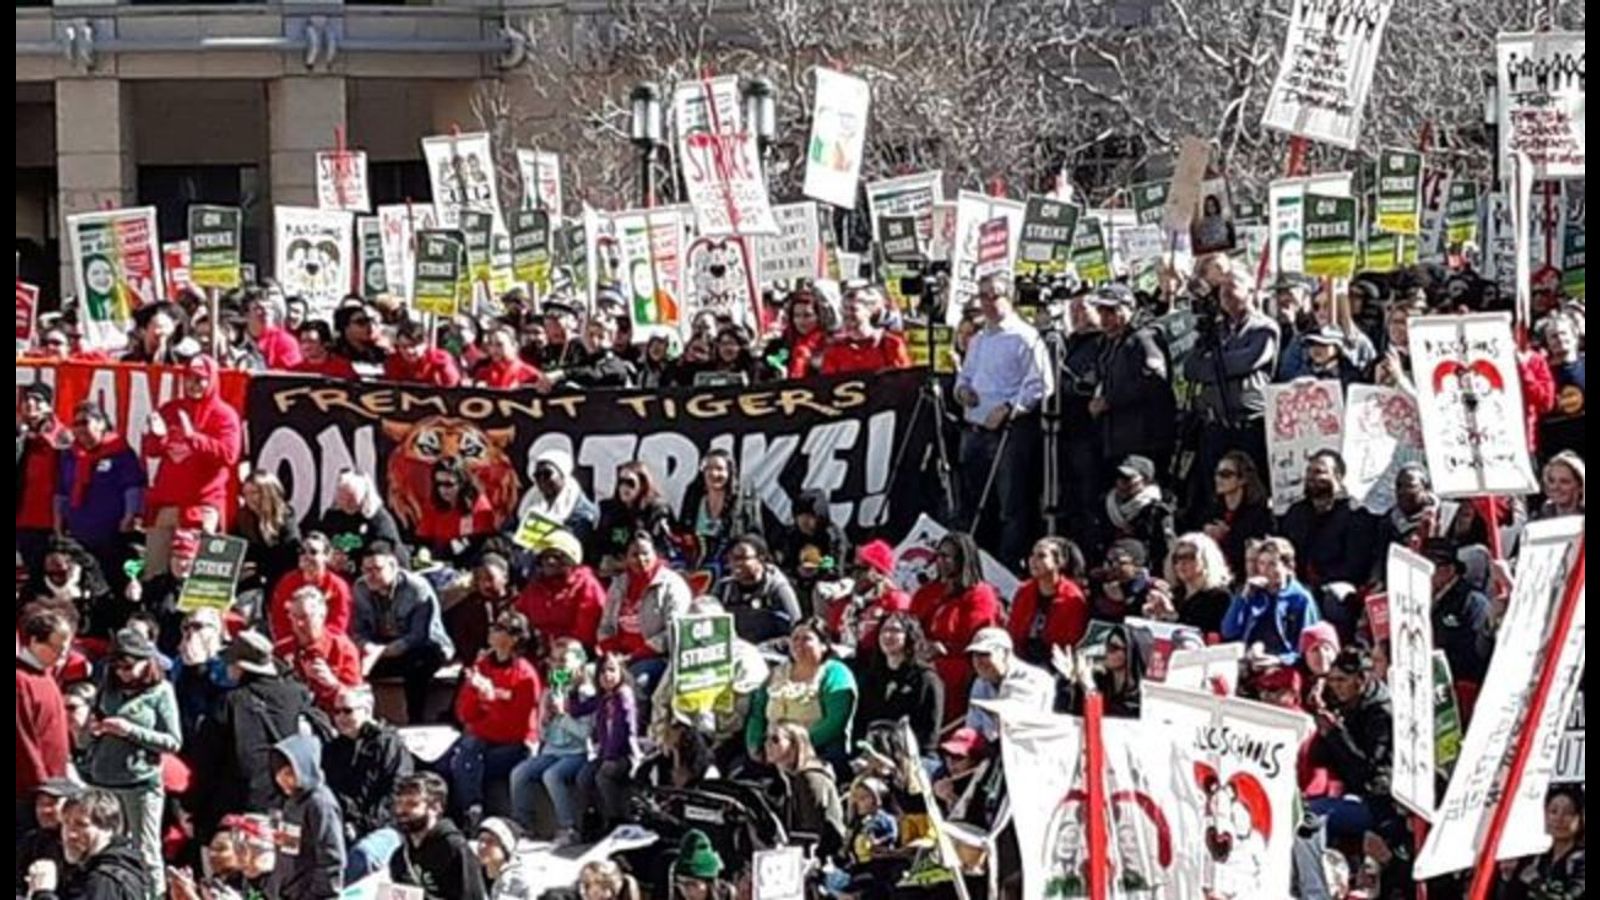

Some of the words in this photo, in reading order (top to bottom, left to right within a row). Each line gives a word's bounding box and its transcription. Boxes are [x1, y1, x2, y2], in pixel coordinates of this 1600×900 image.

[1041, 203, 1061, 219] ON
[1316, 200, 1337, 216] ON
[194, 230, 234, 249] STRIKE
[1025, 222, 1069, 241] STRIKE
[1306, 222, 1352, 239] STRIKE
[273, 386, 586, 420] FREMONT
[617, 381, 867, 419] TIGERS
[256, 425, 379, 522] ON
[528, 410, 895, 529] STRKE!
[194, 559, 233, 577] STRIKE
[692, 620, 714, 640] ON
[681, 642, 728, 668] STRIKE
